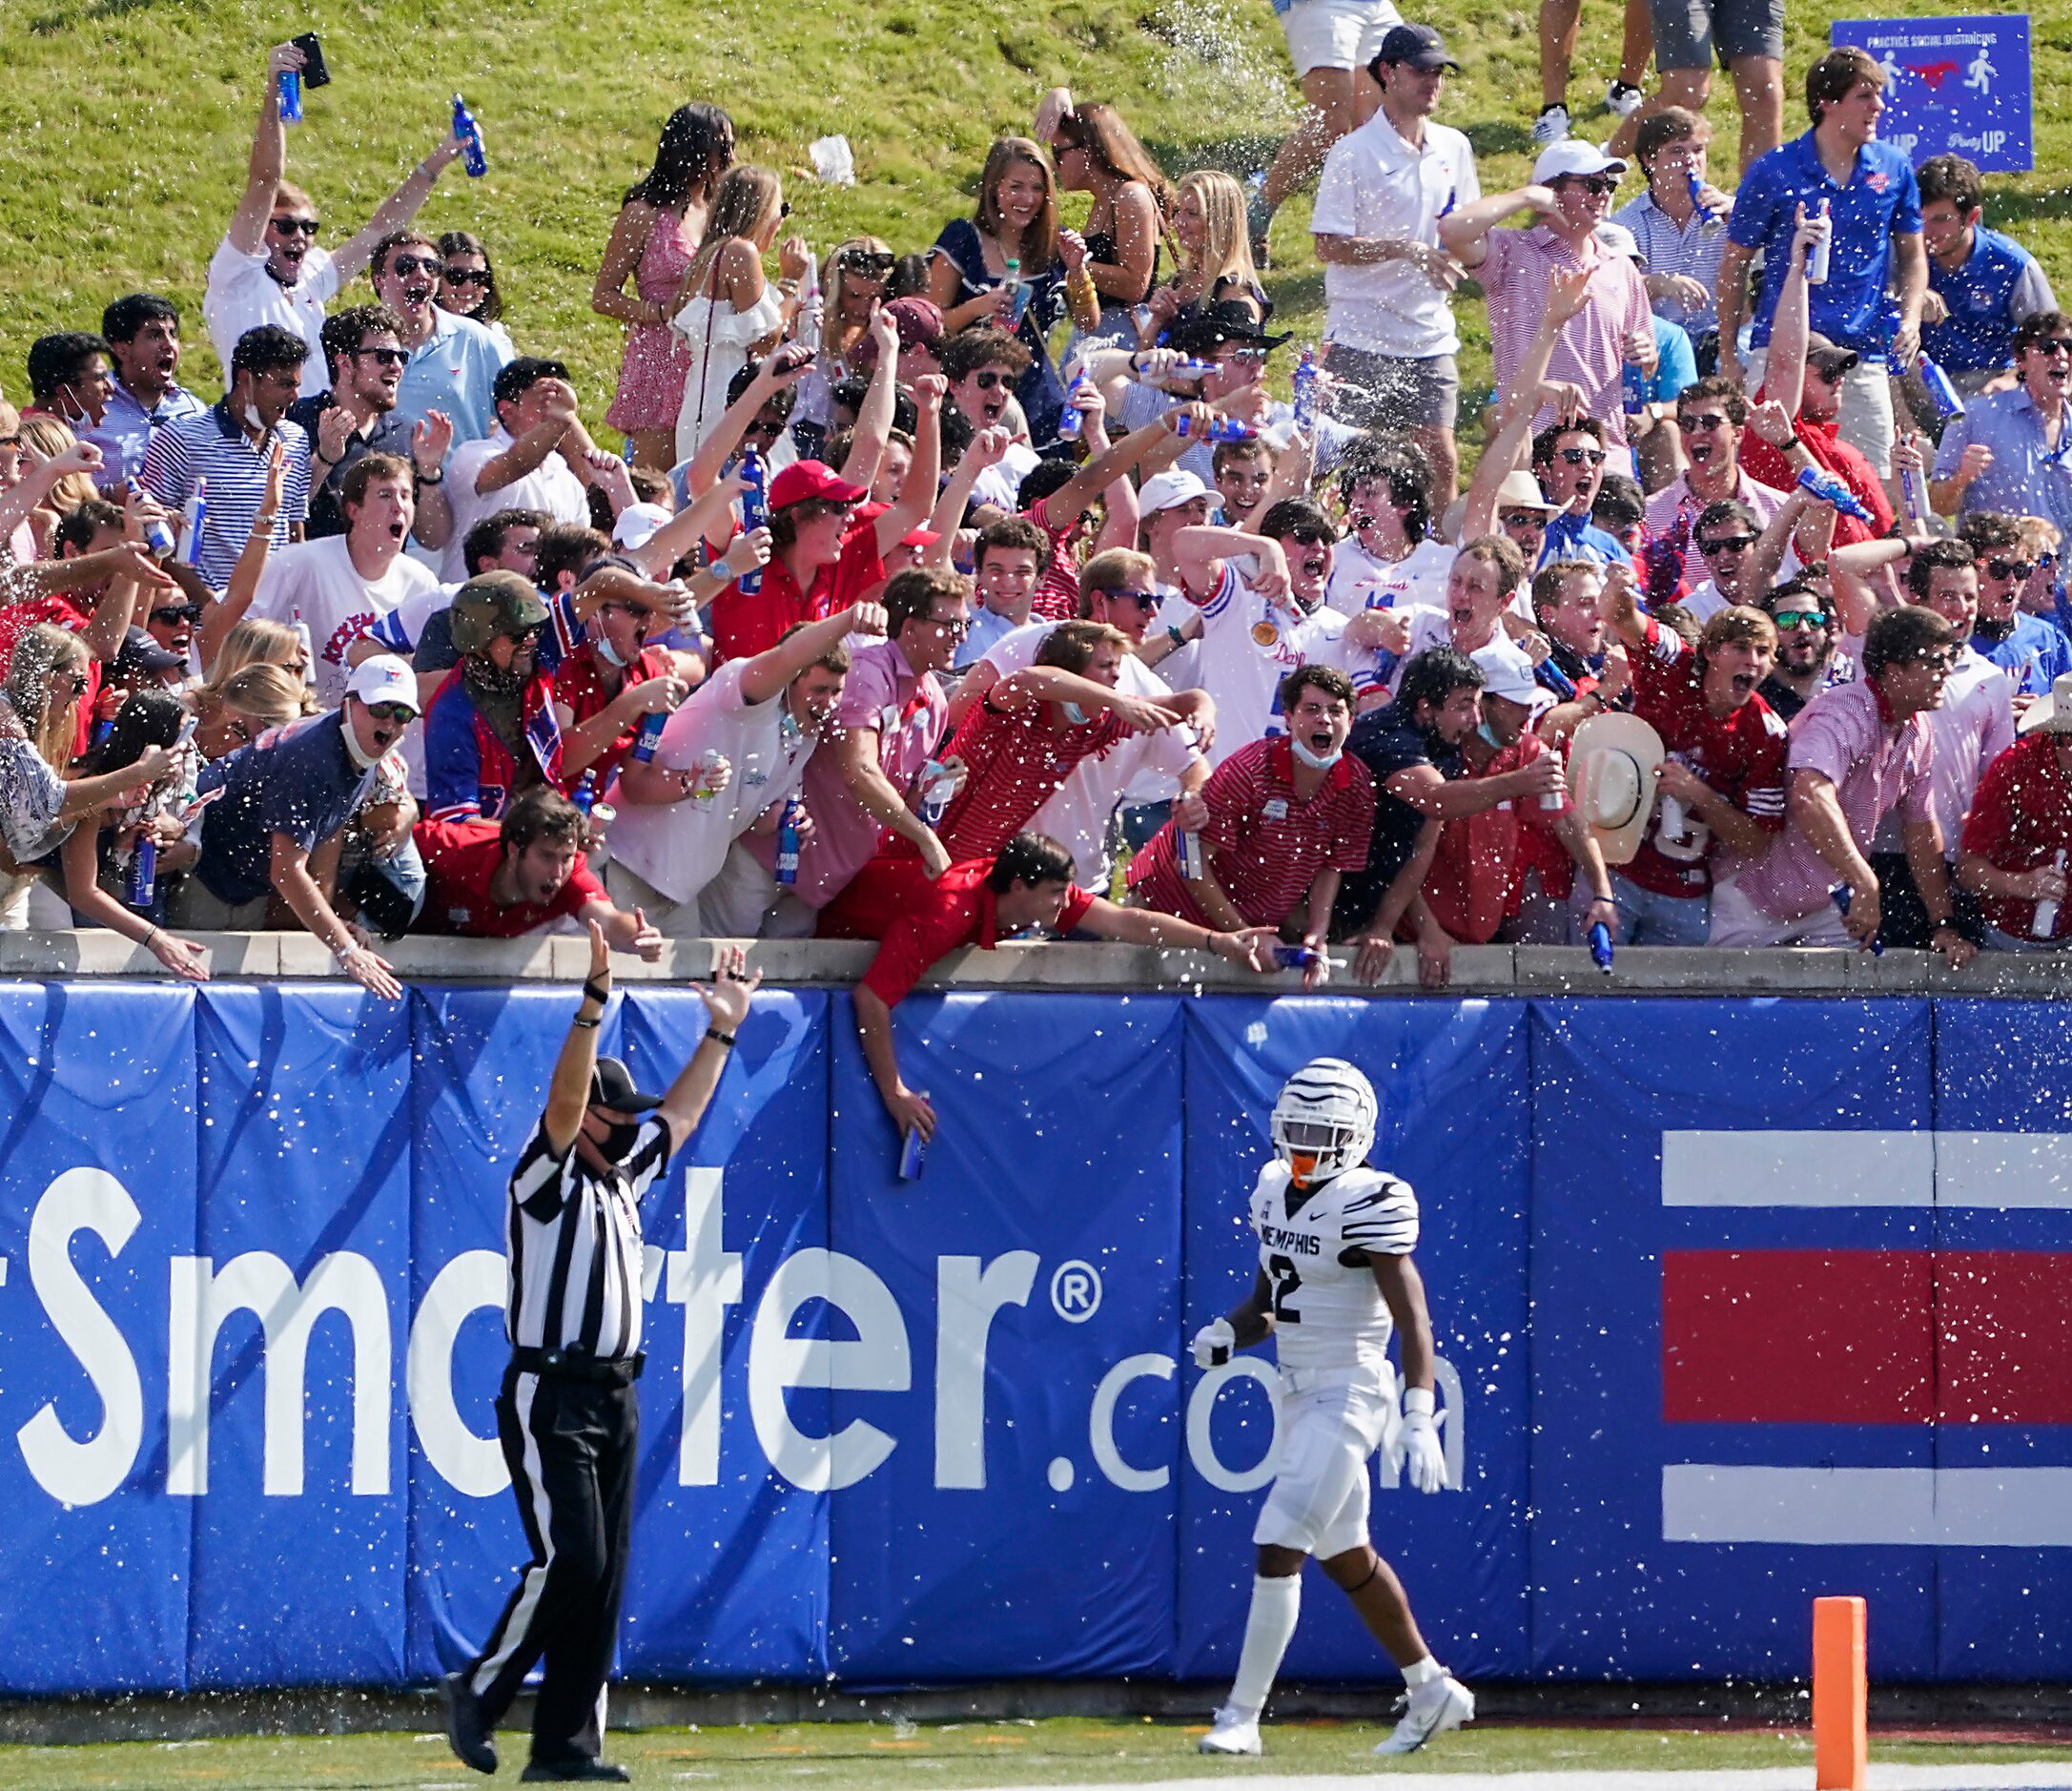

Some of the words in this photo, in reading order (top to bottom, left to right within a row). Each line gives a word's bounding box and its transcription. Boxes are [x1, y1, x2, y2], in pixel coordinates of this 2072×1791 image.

[1867, 35, 1910, 49] PRACTICE
[1911, 34, 1942, 48] SOCIAL
[1944, 32, 1998, 46] DISTANCING
[1947, 133, 1980, 152] Party
[1982, 130, 2005, 153] UP
[1262, 1224, 1321, 1256] MEMPHIS
[1269, 1254, 1303, 1325] 2
